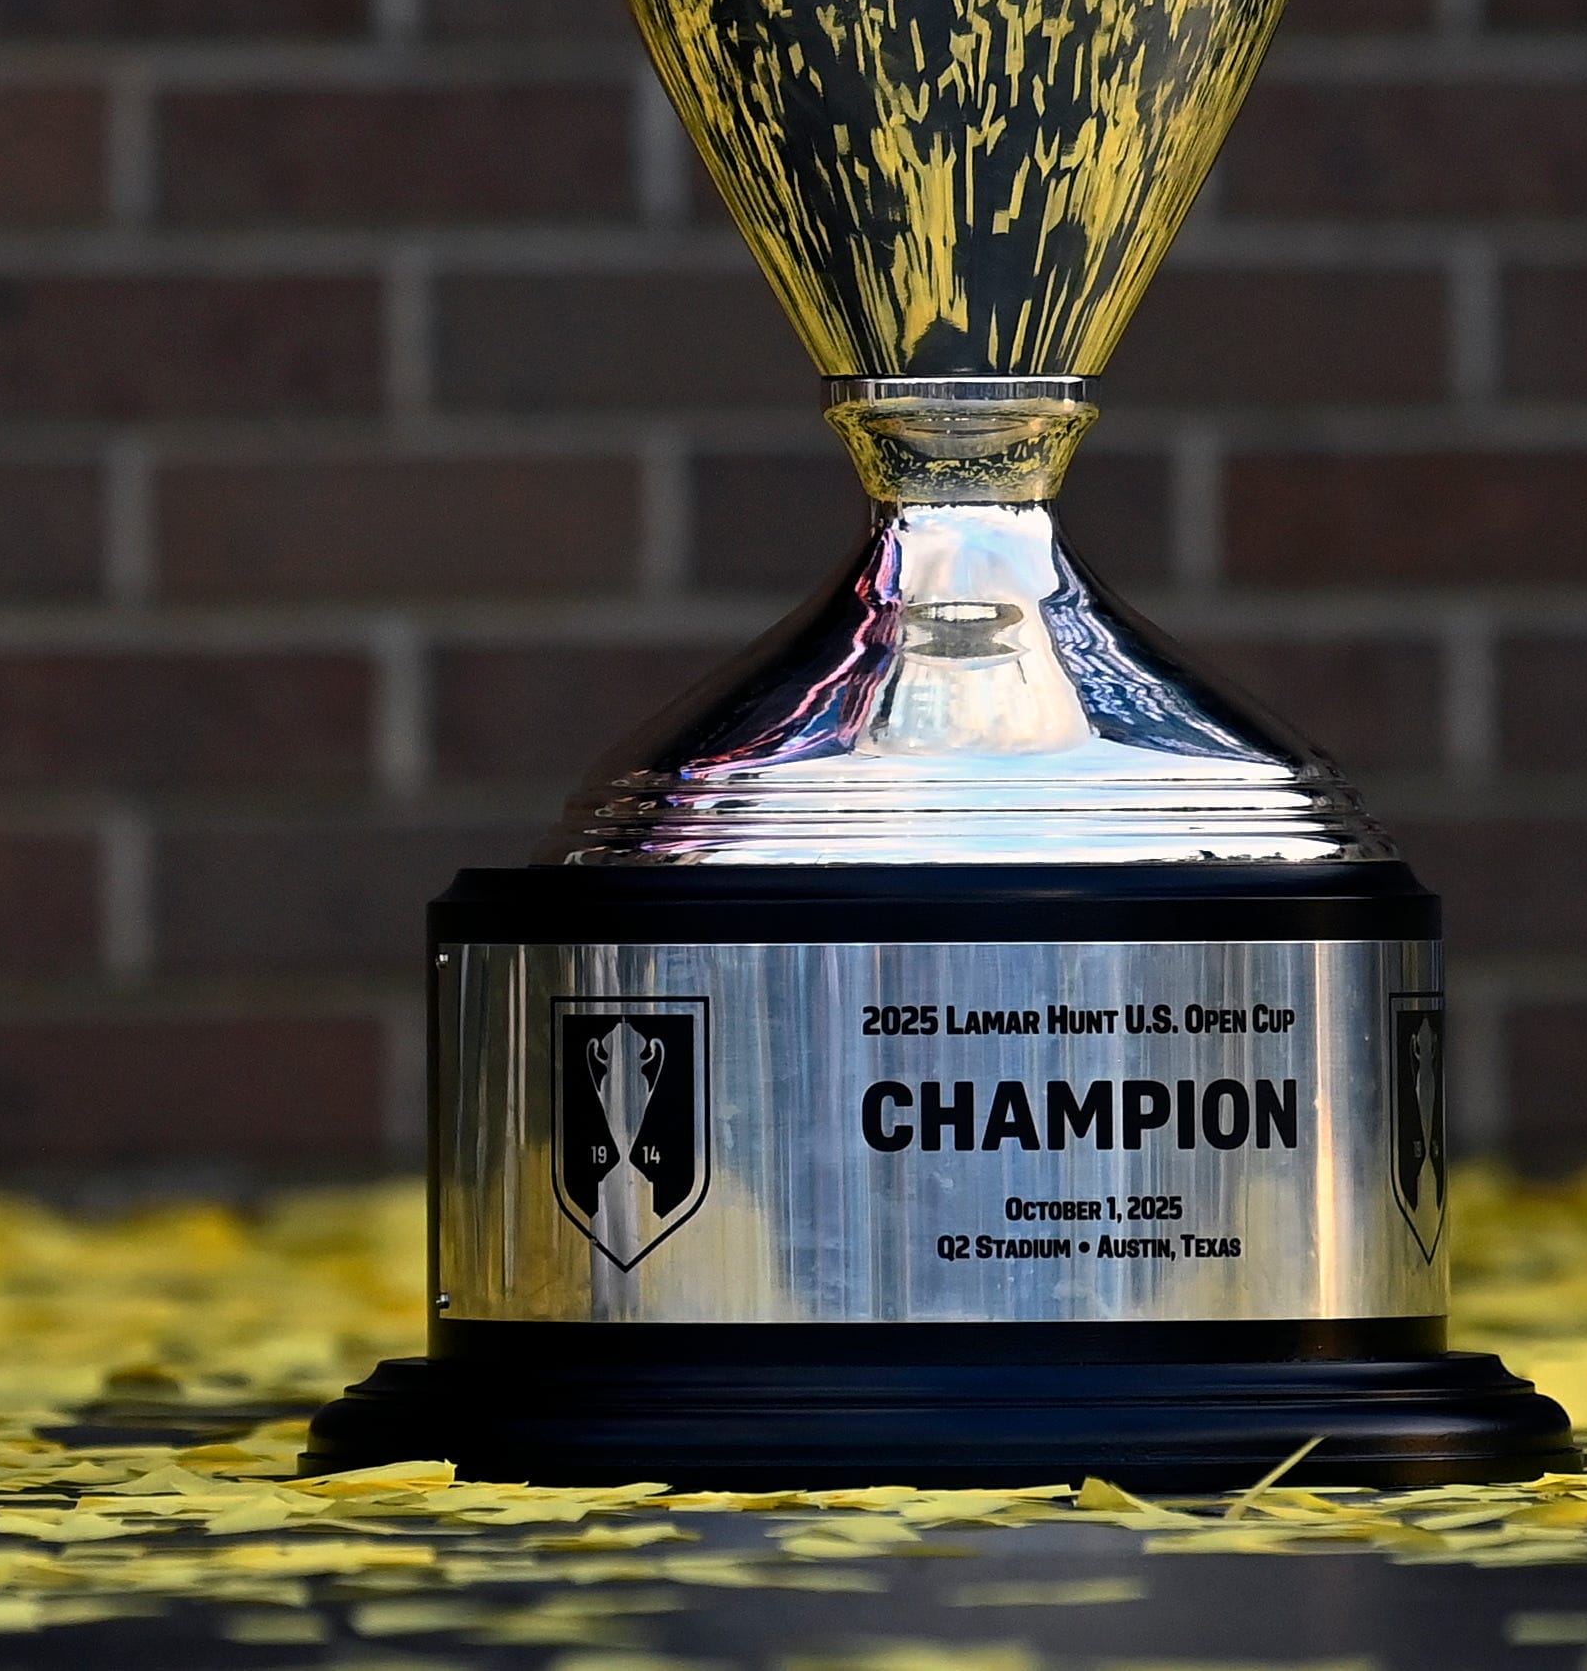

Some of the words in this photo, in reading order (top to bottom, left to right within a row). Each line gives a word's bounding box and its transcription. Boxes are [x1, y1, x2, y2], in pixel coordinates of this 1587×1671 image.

[862, 1005, 938, 1035] 2025
[1125, 1004, 1178, 1034] U.S.
[861, 1078, 1298, 1152] CHAMPION
[591, 1145, 608, 1164] 19
[642, 1145, 661, 1164] 14
[1106, 1196, 1122, 1224] 1,
[1127, 1196, 1183, 1220] 2025
[937, 1235, 970, 1261] Q2
